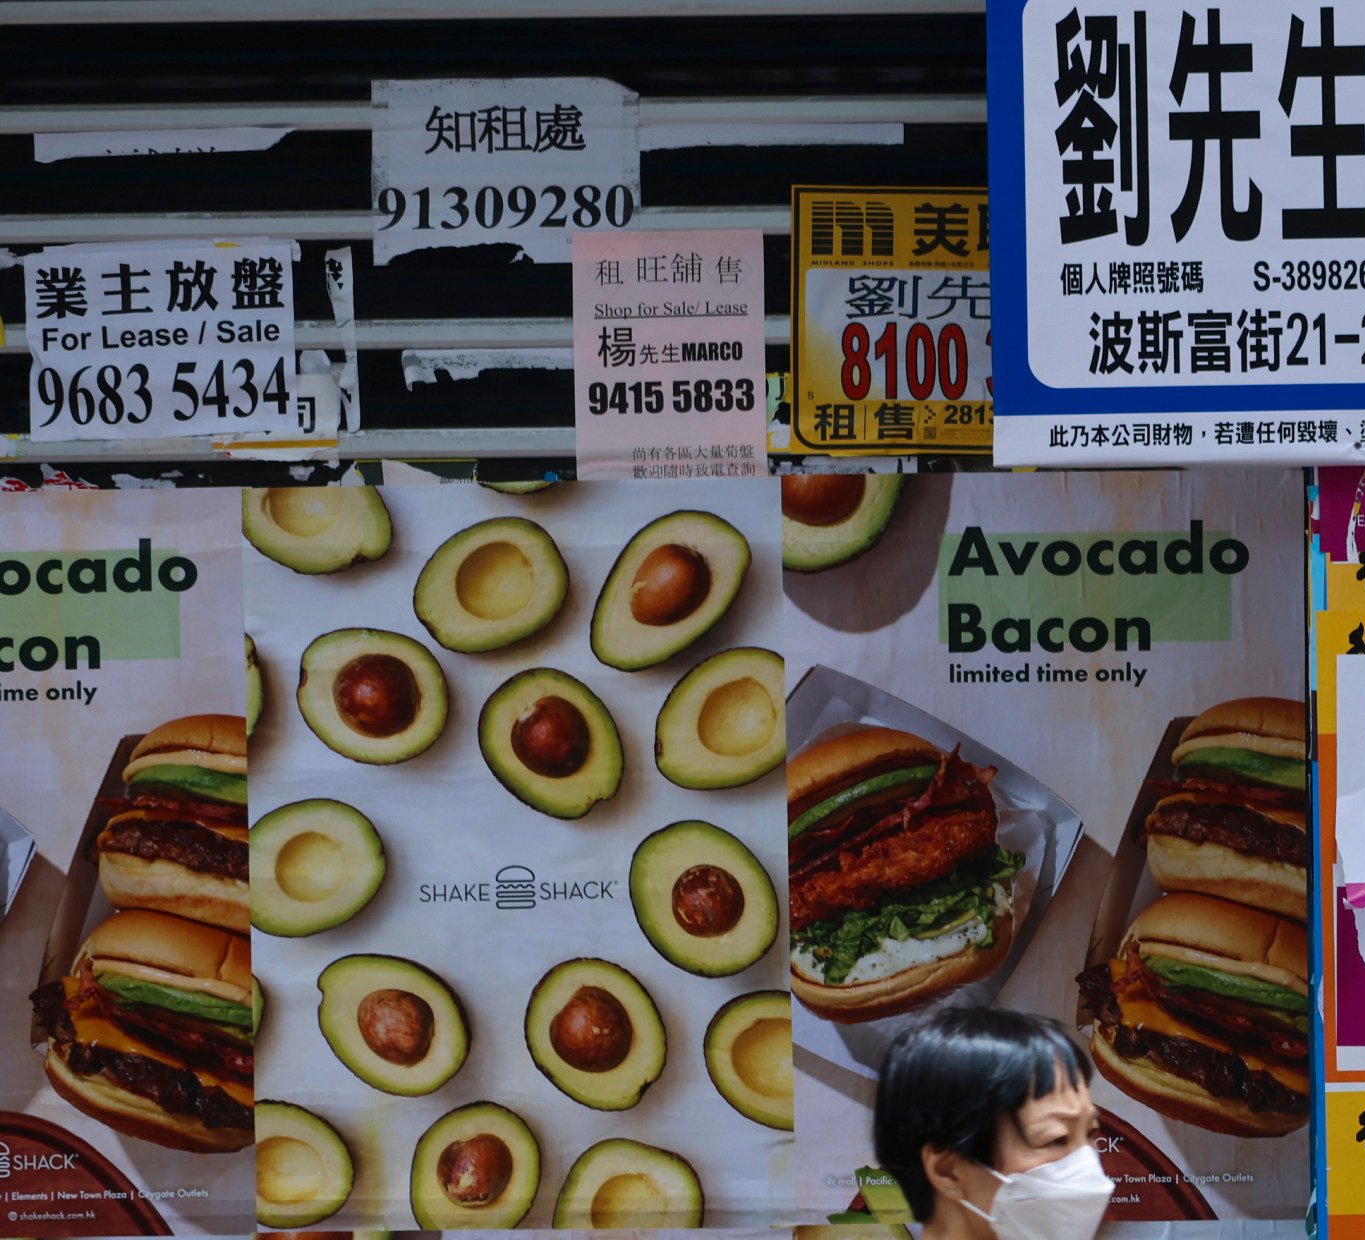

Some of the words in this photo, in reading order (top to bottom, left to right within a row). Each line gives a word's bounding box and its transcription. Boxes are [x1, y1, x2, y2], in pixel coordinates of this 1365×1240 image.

[425, 104, 587, 155] 知租處
[377, 184, 634, 231] 91309280
[36, 256, 285, 319] 業主放盤
[1060, 261, 1204, 296] 個人牌照號碼
[594, 302, 632, 319] Shop
[638, 302, 659, 317] for
[663, 301, 699, 317] Sale/
[705, 300, 748, 316] Lease
[42, 327, 91, 351] For
[101, 324, 189, 350] Lease
[216, 319, 280, 343] Sale
[841, 322, 968, 401] 8100
[37, 362, 153, 428] 9683
[171, 356, 290, 421] 5434
[588, 381, 664, 415] 9415
[673, 378, 755, 413] 5833
[947, 520, 1250, 577] Avocado
[946, 603, 1153, 654] Bacon
[948, 663, 1031, 684] limited
[1036, 662, 1090, 683] time
[1095, 664, 1148, 688] only
[45, 681, 98, 705] only
[420, 883, 491, 904] SHAKE
[539, 881, 615, 902] SHACK
[13, 1153, 78, 1171] SHACK
[11, 1191, 48, 1202] Elements
[57, 1190, 78, 1201] New
[80, 1190, 102, 1200] Town
[103, 1189, 128, 1200] Plaza
[137, 1189, 175, 1201] Citygate
[177, 1187, 209, 1198] Outlets
[865, 1175, 893, 1186] Pacific
[1124, 1174, 1147, 1184] Town
[1148, 1173, 1172, 1184] Plaza
[1183, 1173, 1220, 1185] Citygate
[1222, 1172, 1254, 1183] Outlets
[20, 1210, 97, 1221] shakeshack.com.hk
